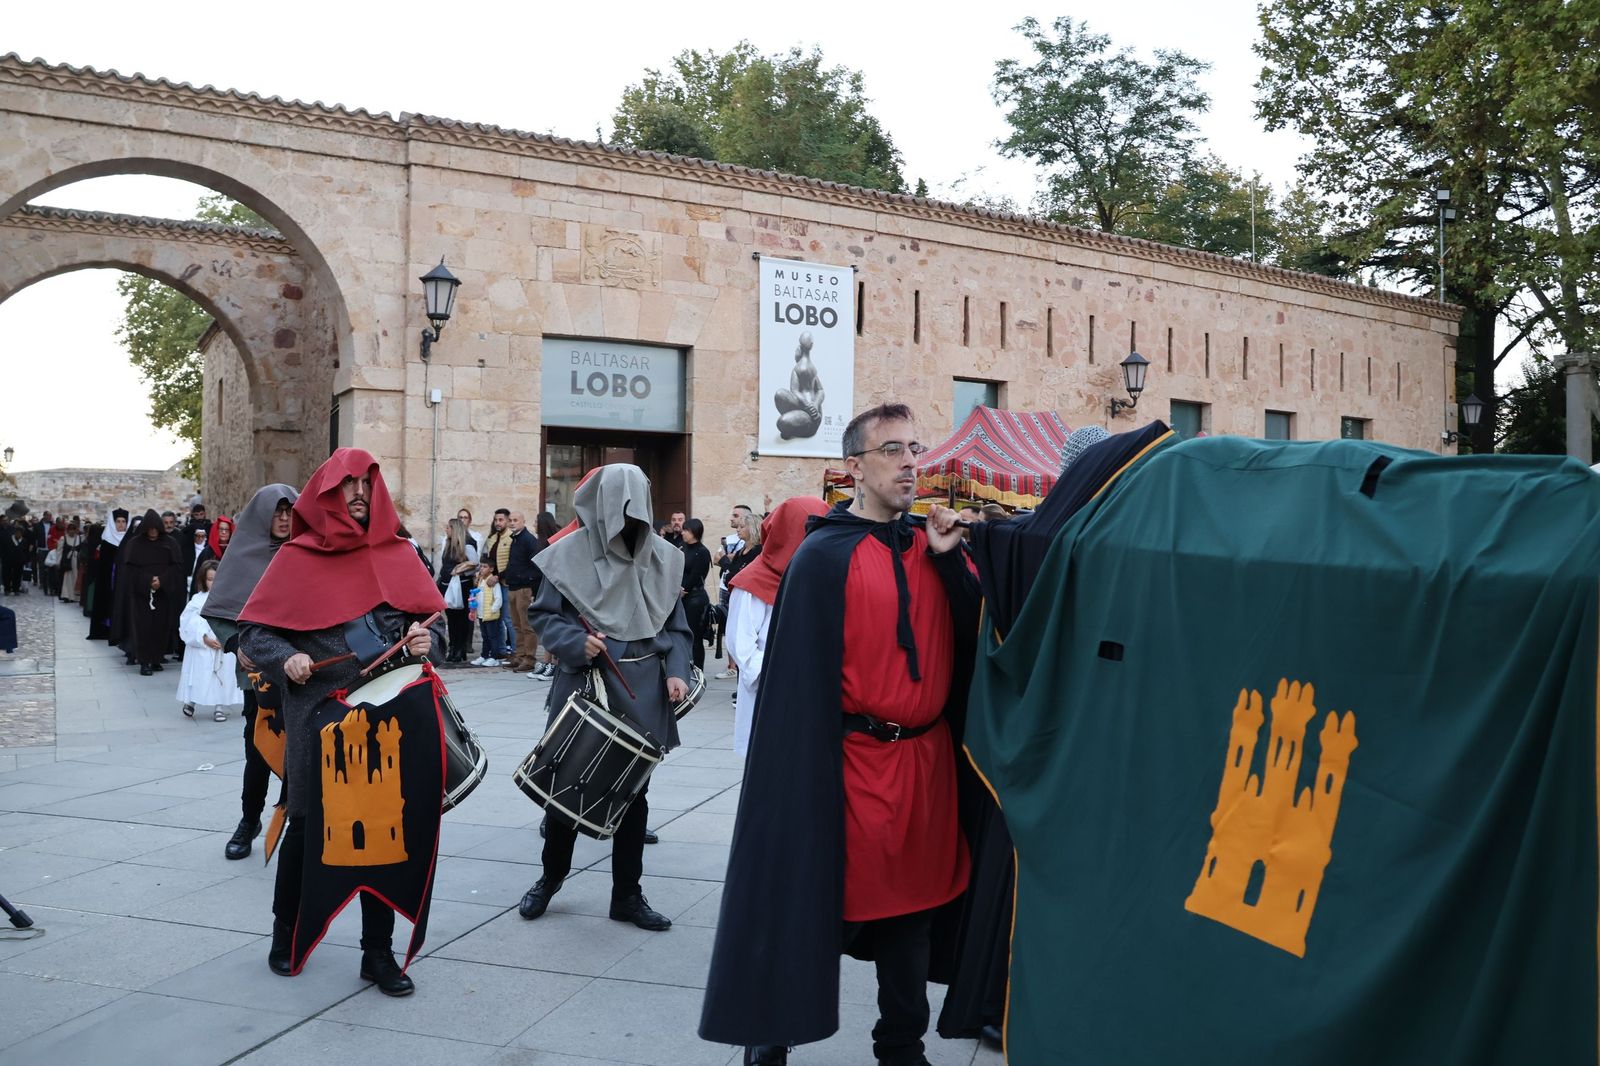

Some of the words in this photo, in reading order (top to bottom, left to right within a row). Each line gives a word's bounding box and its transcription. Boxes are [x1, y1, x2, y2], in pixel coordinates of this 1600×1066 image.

[774, 269, 839, 286] MUSEO
[774, 284, 839, 303] BALTASAR
[774, 301, 839, 328] LOBO
[570, 350, 650, 370] BALTASAR
[570, 370, 652, 400] LOBO
